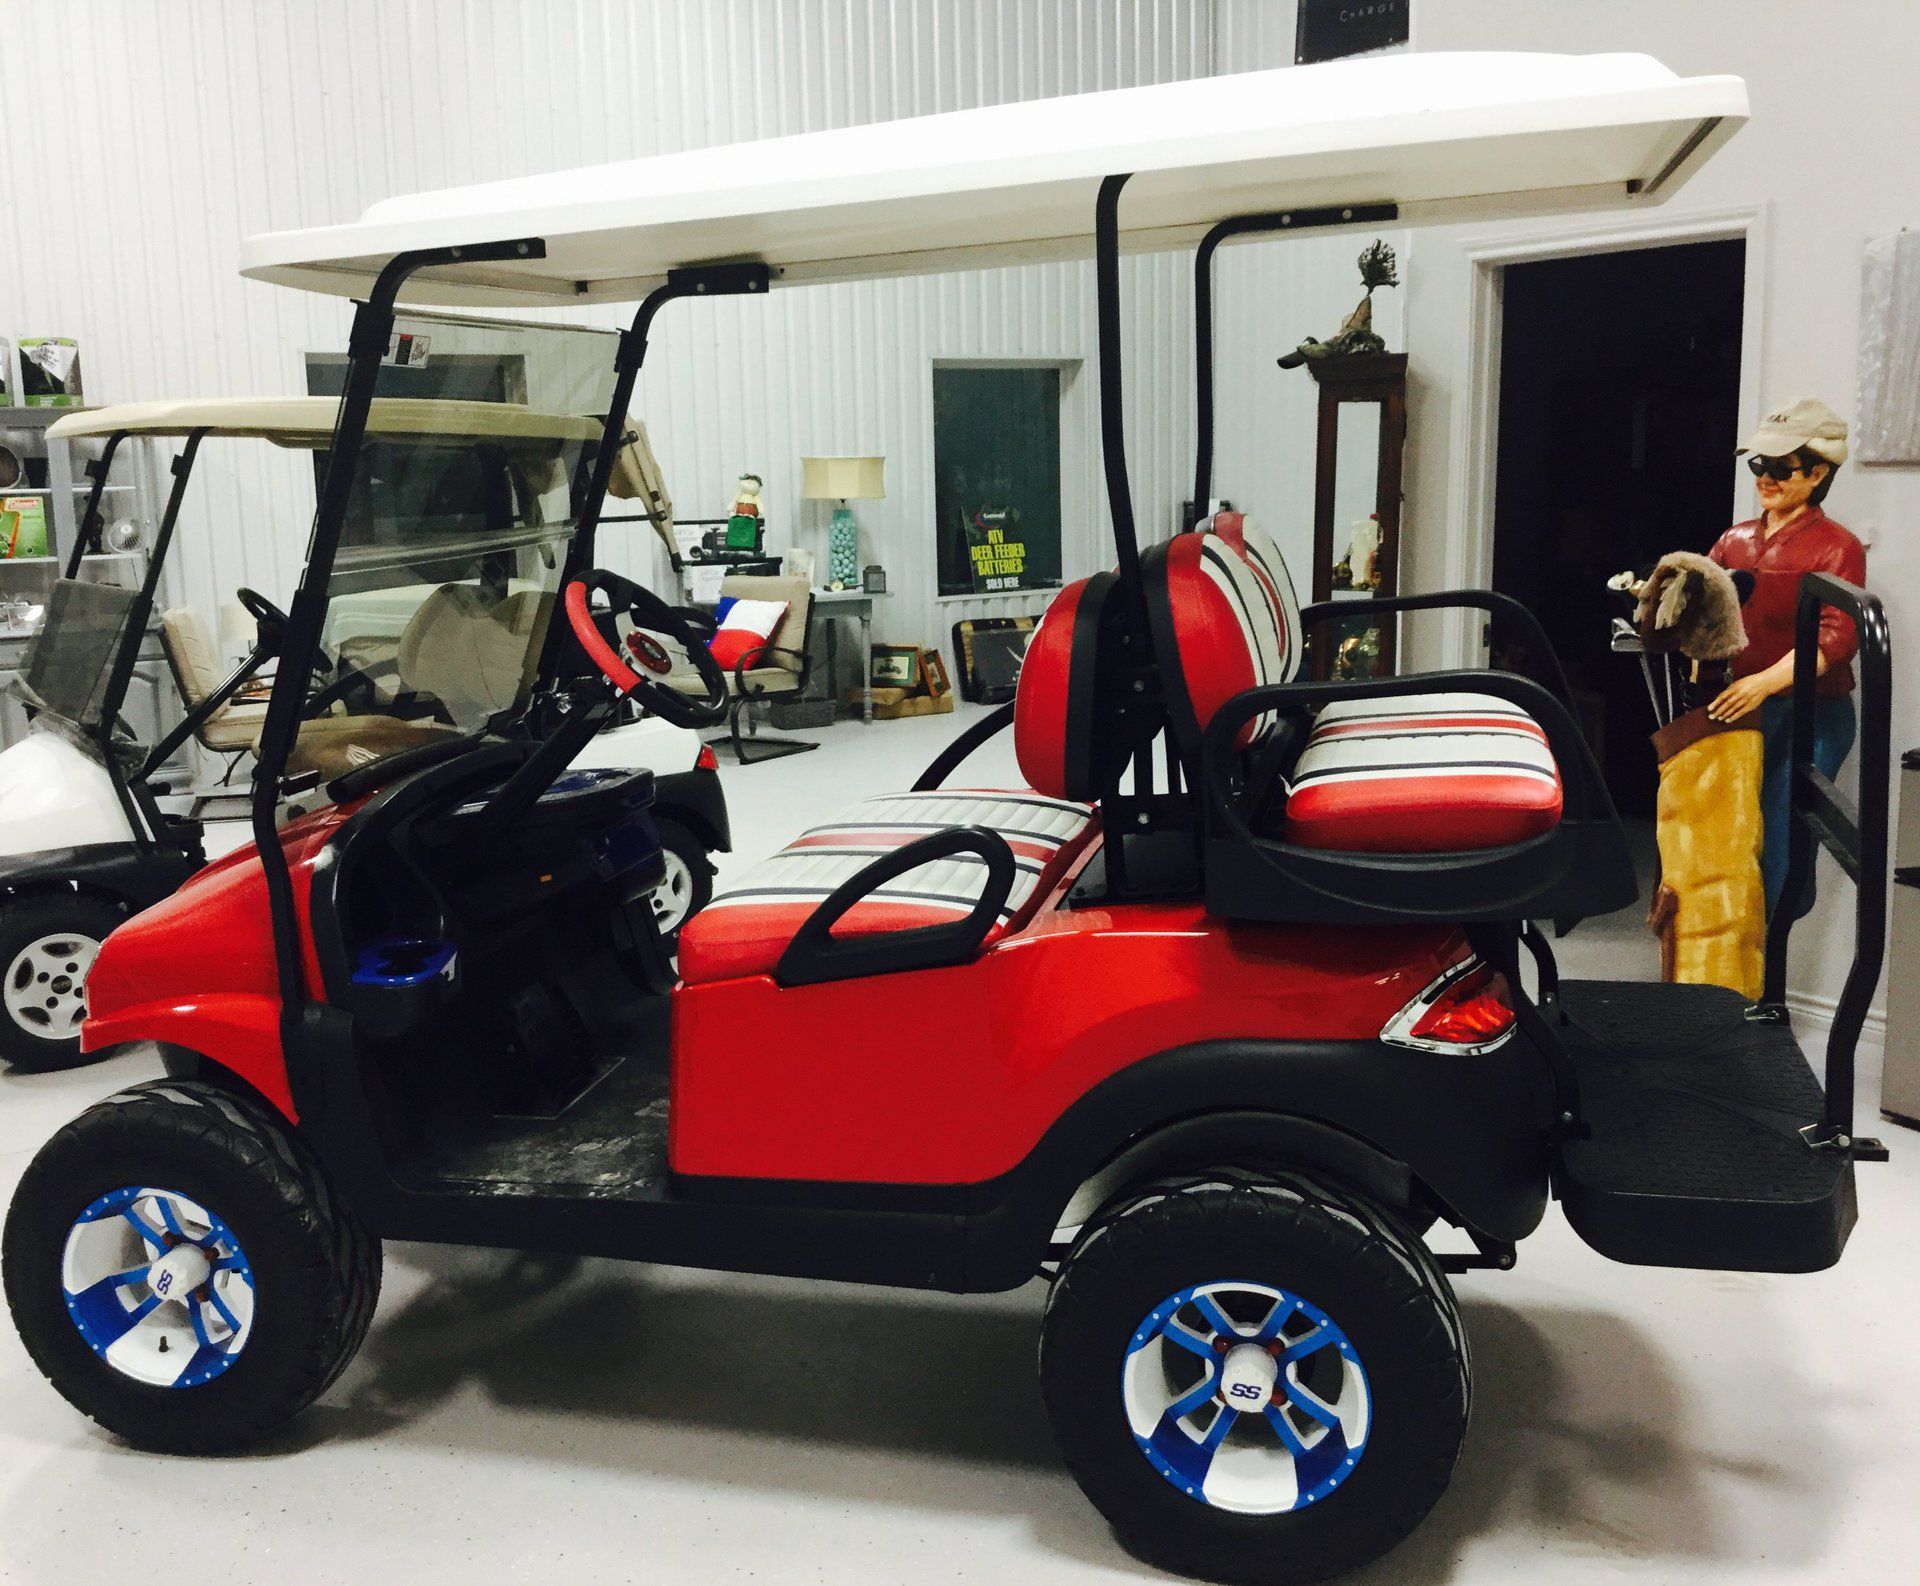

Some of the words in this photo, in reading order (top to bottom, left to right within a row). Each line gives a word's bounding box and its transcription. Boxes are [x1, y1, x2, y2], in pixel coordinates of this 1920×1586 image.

[988, 529, 1004, 544] ATV
[971, 545, 993, 561] DEER
[994, 543, 1025, 558] FEEDER
[977, 558, 1023, 575] BATTERIES
[986, 578, 1003, 590] SOLD
[1003, 577, 1019, 588] HERE
[156, 1269, 173, 1295] SS
[1230, 1383, 1262, 1399] SS
